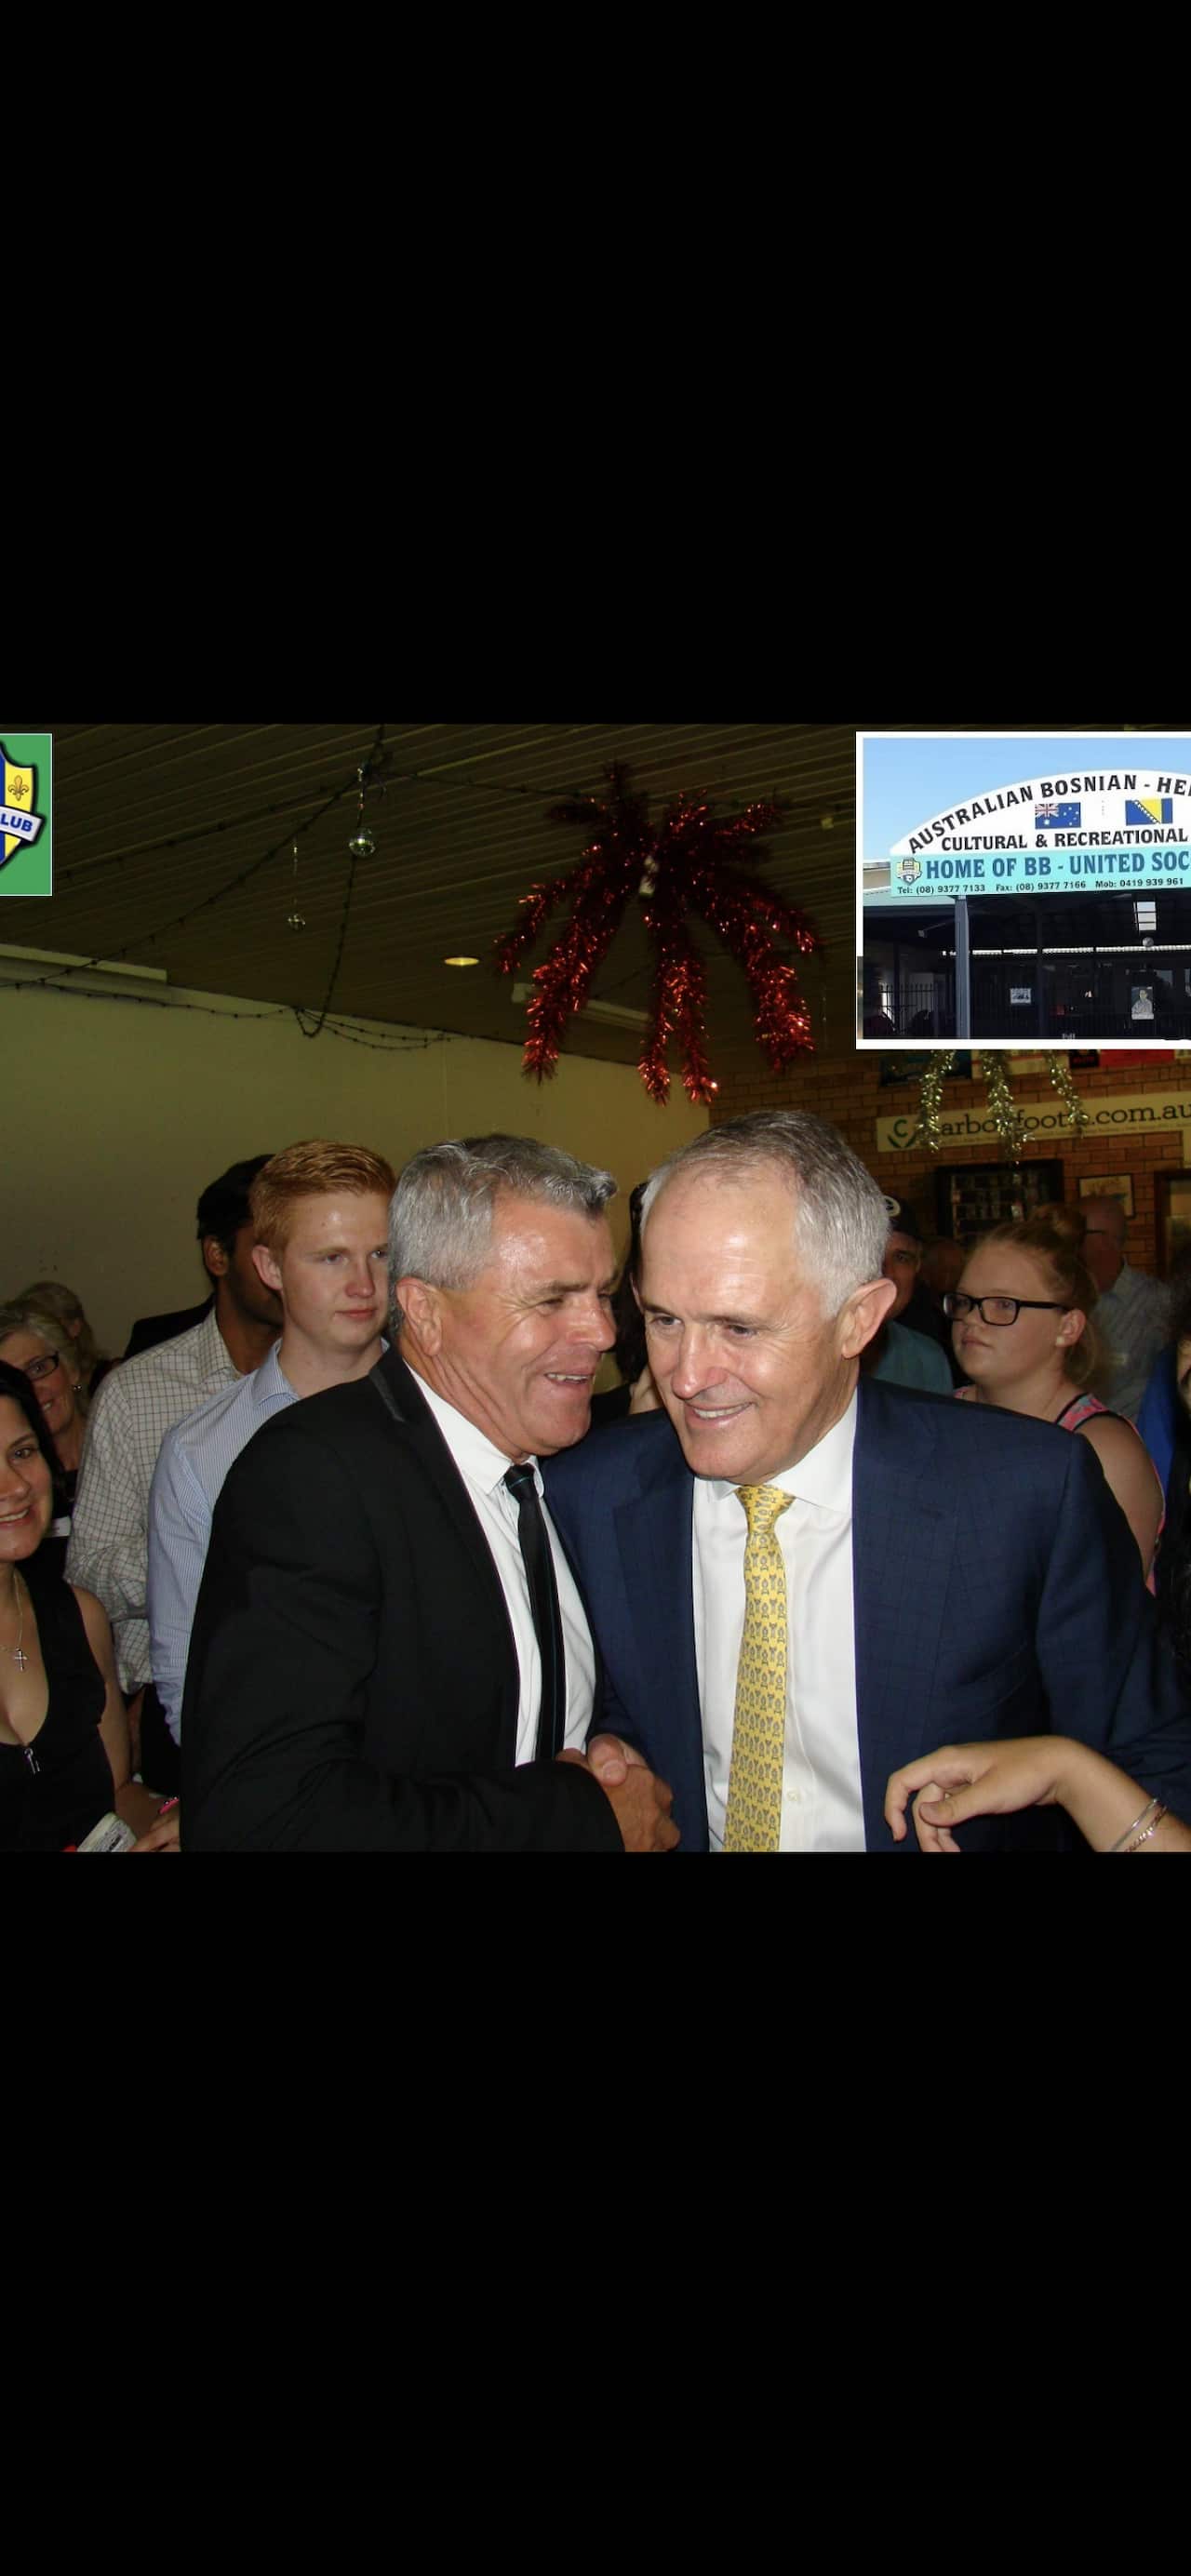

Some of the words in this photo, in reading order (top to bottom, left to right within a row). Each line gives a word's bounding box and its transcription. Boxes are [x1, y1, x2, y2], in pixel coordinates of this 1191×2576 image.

[908, 785, 1034, 854] AUSTRALIAN
[1040, 774, 1137, 798] BOSNIAN
[942, 834, 1028, 851] CULTURAL
[1036, 834, 1048, 848] &
[1054, 828, 1188, 848] RECREATIONAL
[926, 859, 985, 879] HOME
[992, 858, 1017, 877] OF
[1024, 856, 1051, 875] BB
[1069, 852, 1145, 874] UNITED
[916, 886, 934, 895] (08)
[963, 884, 985, 892] 7133
[996, 884, 1012, 892] Fax:
[1016, 883, 1034, 892] (08)
[1037, 882, 1060, 890] 9377
[1095, 880, 1117, 888] Mob:
[1145, 878, 1163, 887] 939
[1167, 877, 1184, 886] 961
